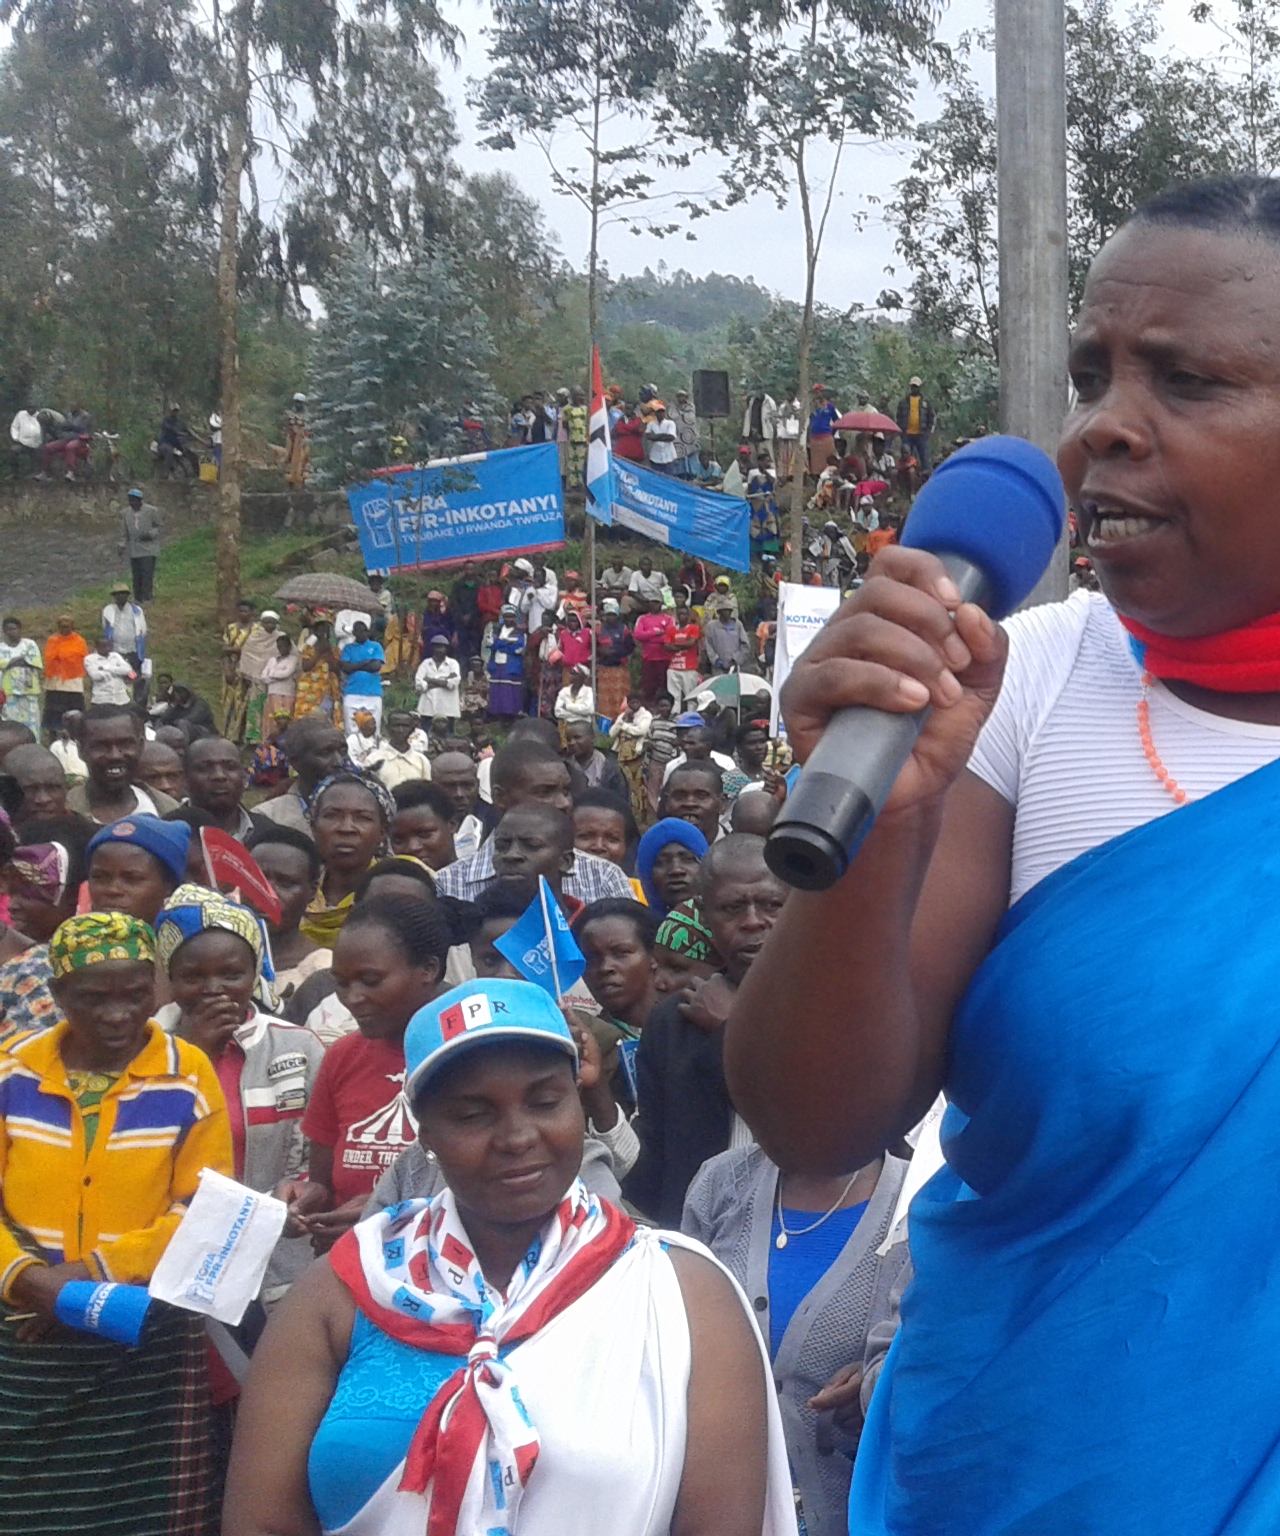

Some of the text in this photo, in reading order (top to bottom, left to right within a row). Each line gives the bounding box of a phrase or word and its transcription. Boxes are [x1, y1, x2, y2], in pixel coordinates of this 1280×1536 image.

[399, 493, 558, 533] FPR-INKOTANYI
[465, 519, 513, 535] RWANDA
[342, 1149, 373, 1164] UNDER
